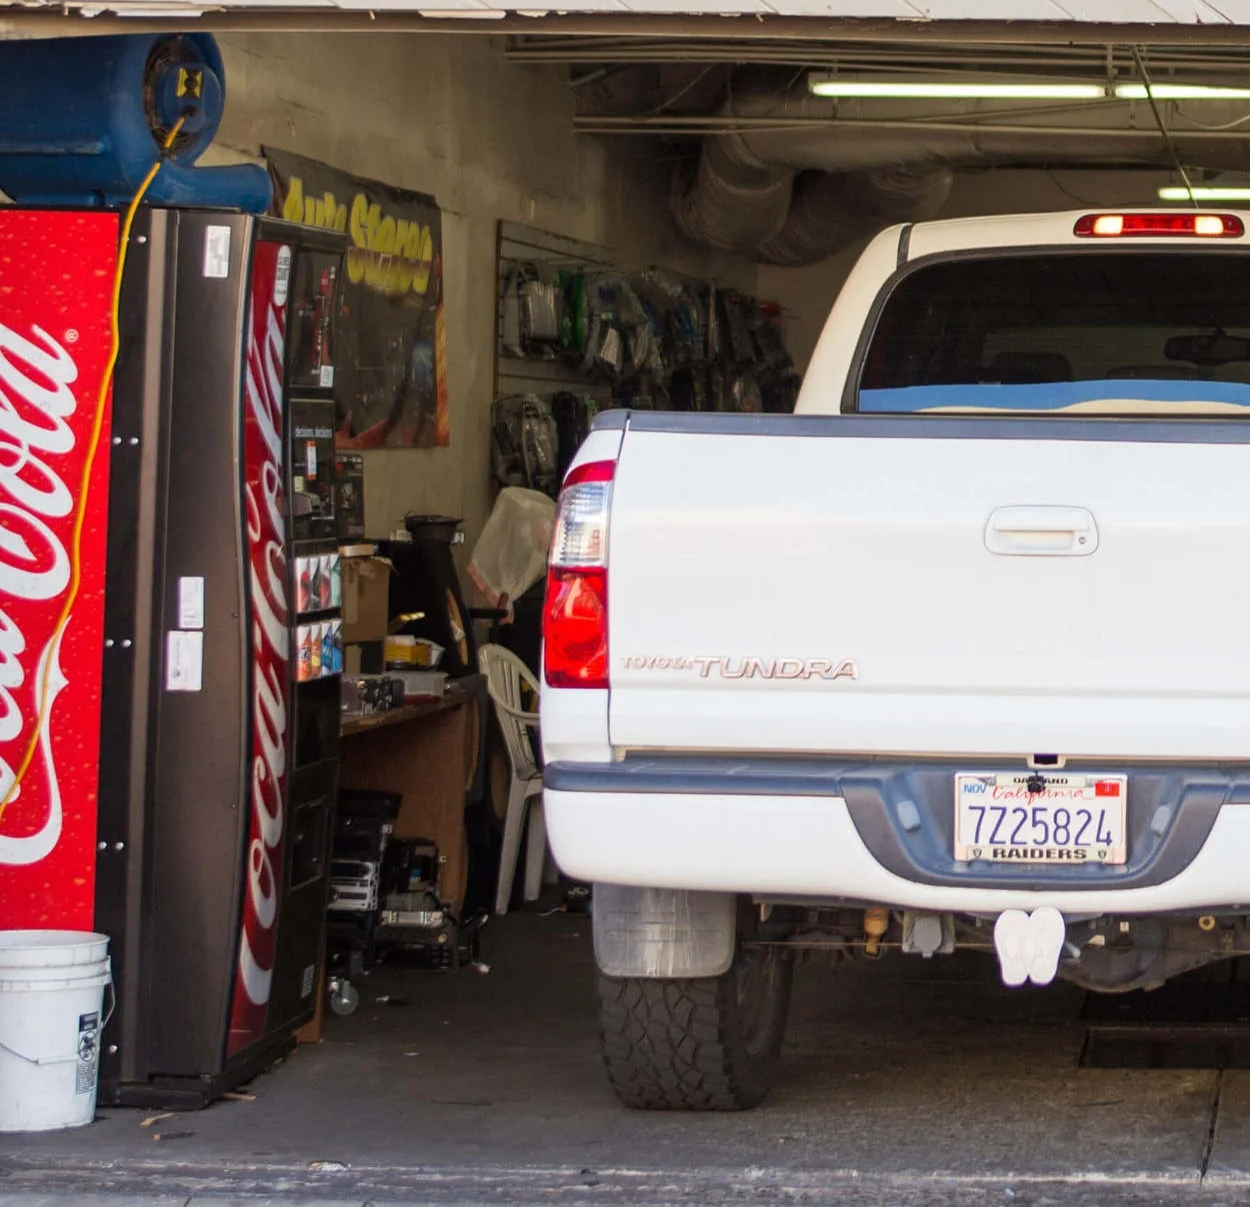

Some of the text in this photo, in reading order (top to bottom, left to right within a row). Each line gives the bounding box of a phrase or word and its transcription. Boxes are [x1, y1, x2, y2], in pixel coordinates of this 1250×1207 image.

[621, 656, 859, 680] TOYOTA TUNDRA
[963, 784, 987, 794] NOV
[968, 805, 1113, 846] 7Z25824
[992, 848, 1087, 860] RAIDERS
